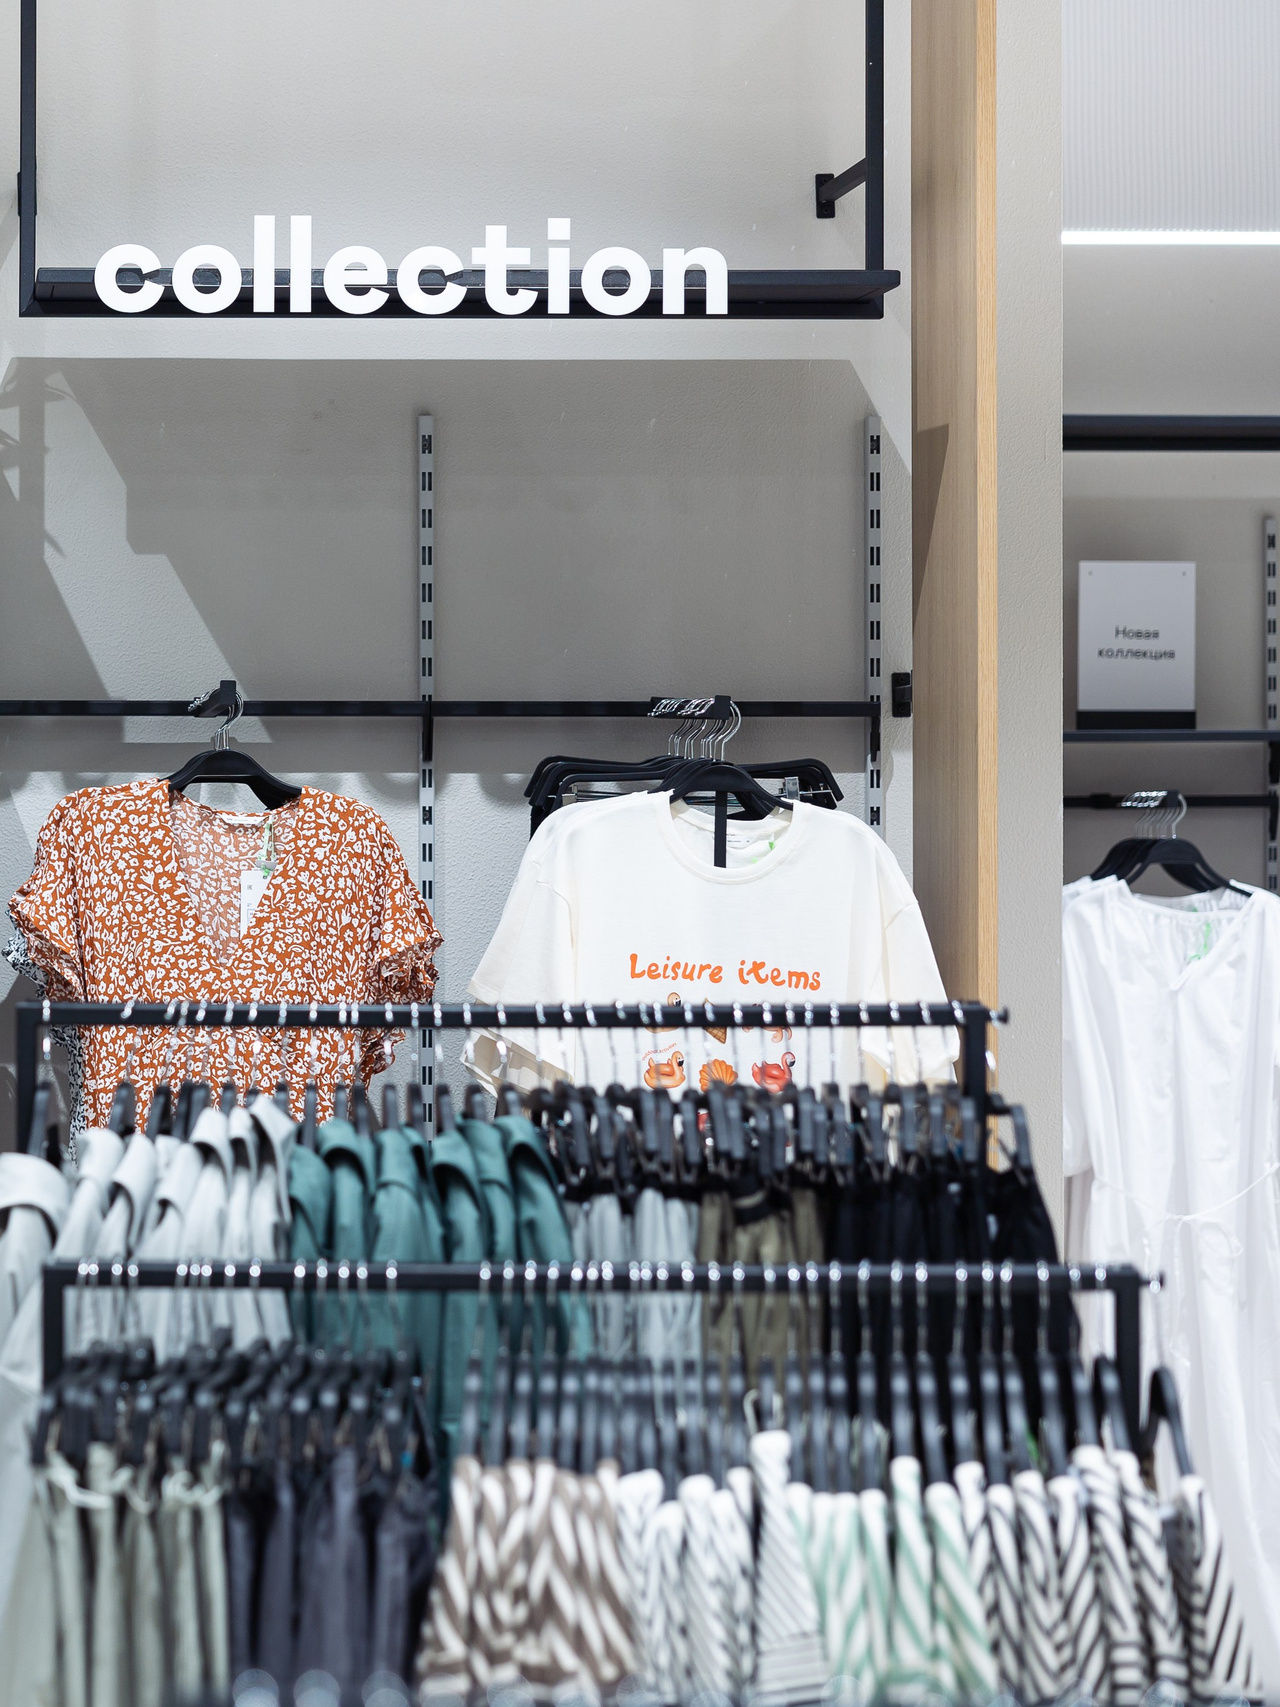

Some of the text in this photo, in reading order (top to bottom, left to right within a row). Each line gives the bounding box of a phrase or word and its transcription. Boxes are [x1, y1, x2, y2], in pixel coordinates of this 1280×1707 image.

[94, 214, 729, 315] collection
[1115, 625, 1160, 640] Новая
[1097, 647, 1176, 661] коллекция
[629, 953, 821, 991] Leisure items
